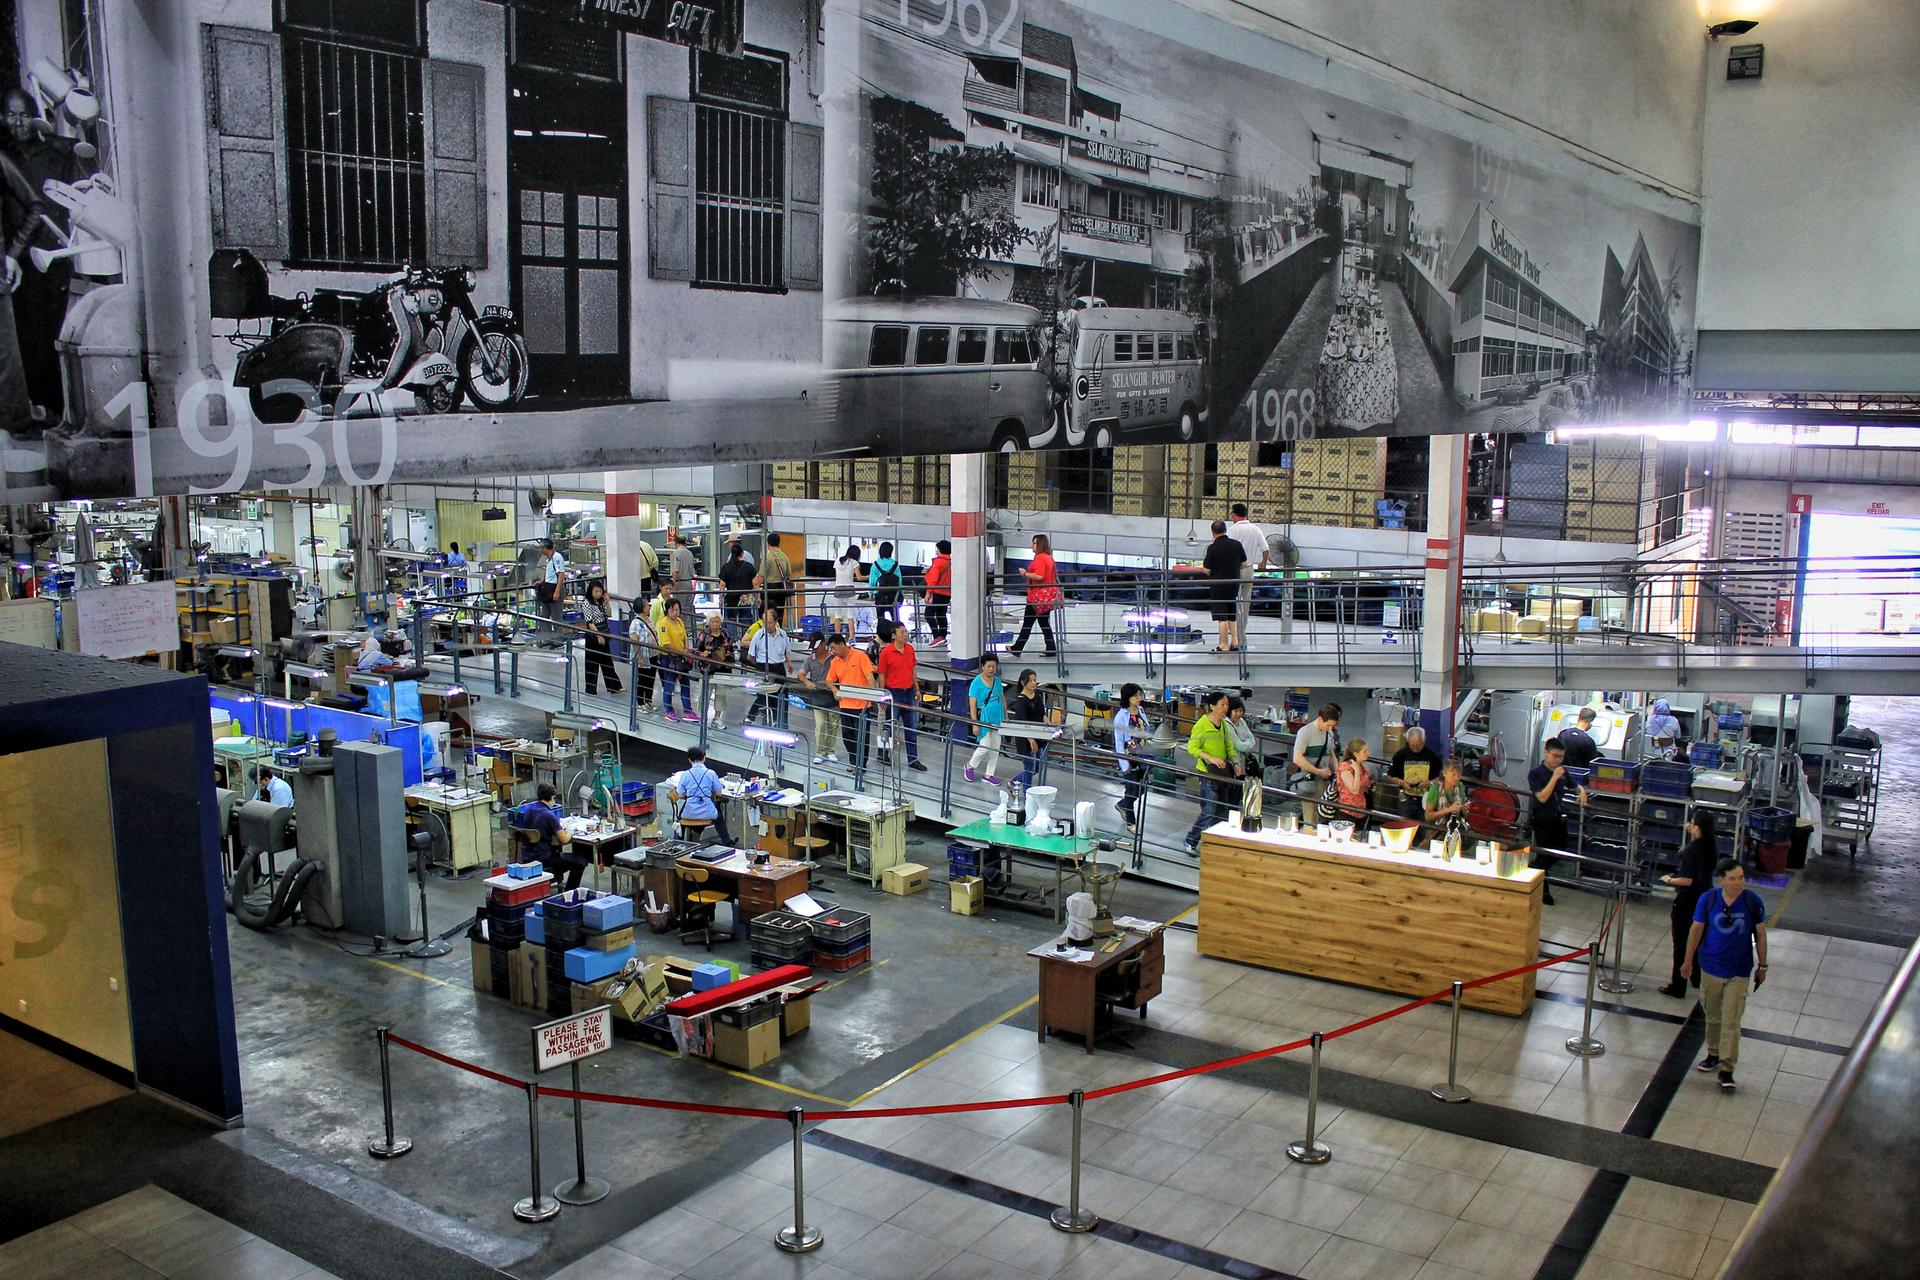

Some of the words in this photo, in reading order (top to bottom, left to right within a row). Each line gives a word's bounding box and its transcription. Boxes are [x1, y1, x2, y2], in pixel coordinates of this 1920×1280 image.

[668, 1, 714, 33] GIFT
[1087, 141, 1121, 164] SELANGOR
[1122, 150, 1147, 170] PEWTER
[1491, 219, 1522, 272] Selangor
[486, 307, 497, 315] NA
[499, 308, 513, 319] 189
[1112, 371, 1147, 389] SELANGOR
[1151, 370, 1176, 386] PEWTER
[1246, 388, 1316, 441] 1968
[102, 378, 398, 497] 1930
[543, 1022, 577, 1040] PLEASE
[584, 1014, 603, 1027] STAY
[548, 1031, 578, 1047] WITHIN
[583, 1024, 600, 1036] THE
[545, 1032, 603, 1058] PASSAGEWAY
[569, 1045, 590, 1058] THANK
[593, 1040, 605, 1051] YOU
